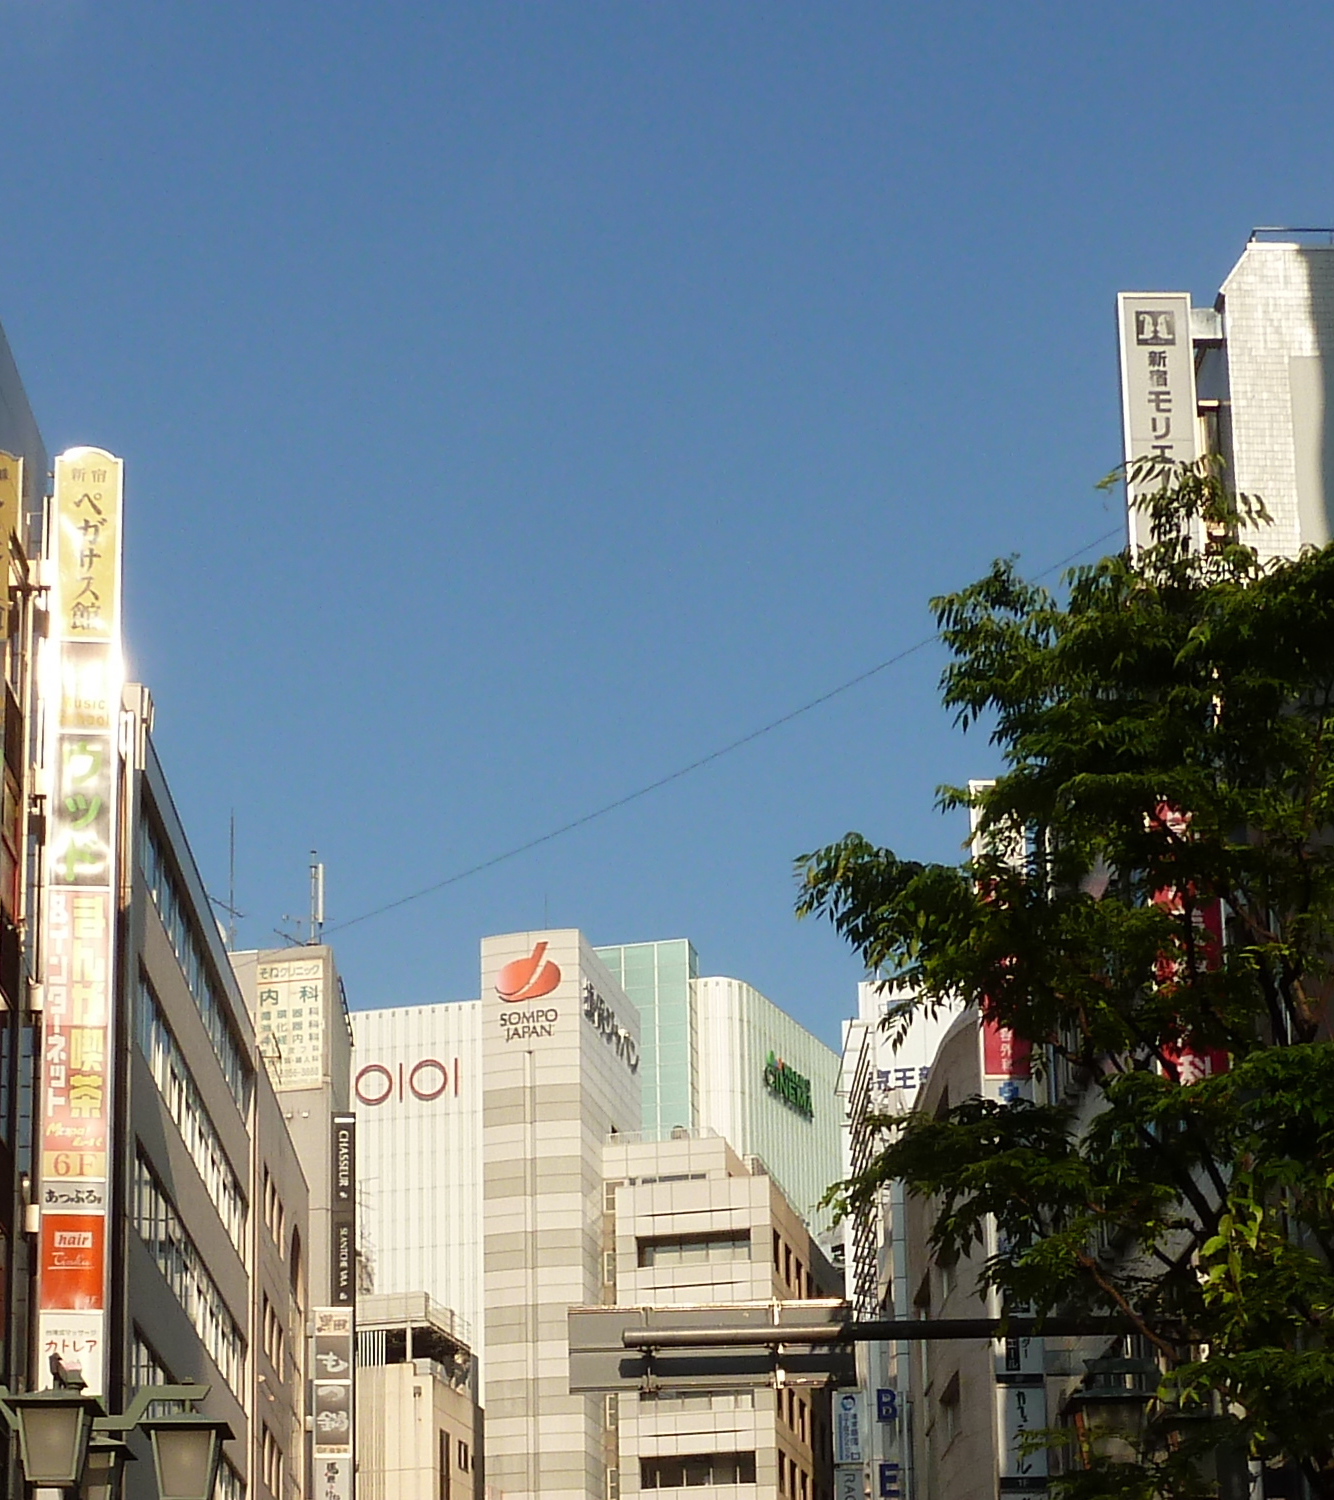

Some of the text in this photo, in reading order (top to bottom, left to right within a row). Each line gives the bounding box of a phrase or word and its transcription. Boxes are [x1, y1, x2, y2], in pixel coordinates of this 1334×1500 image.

[499, 1008, 558, 1028] SOMPO
[504, 1024, 554, 1042] JAPAN
[53, 1152, 97, 1177] 6F
[338, 1130, 349, 1187] CHASSEUR
[56, 1231, 90, 1247] hair
[45, 1338, 97, 1354] カトレア
